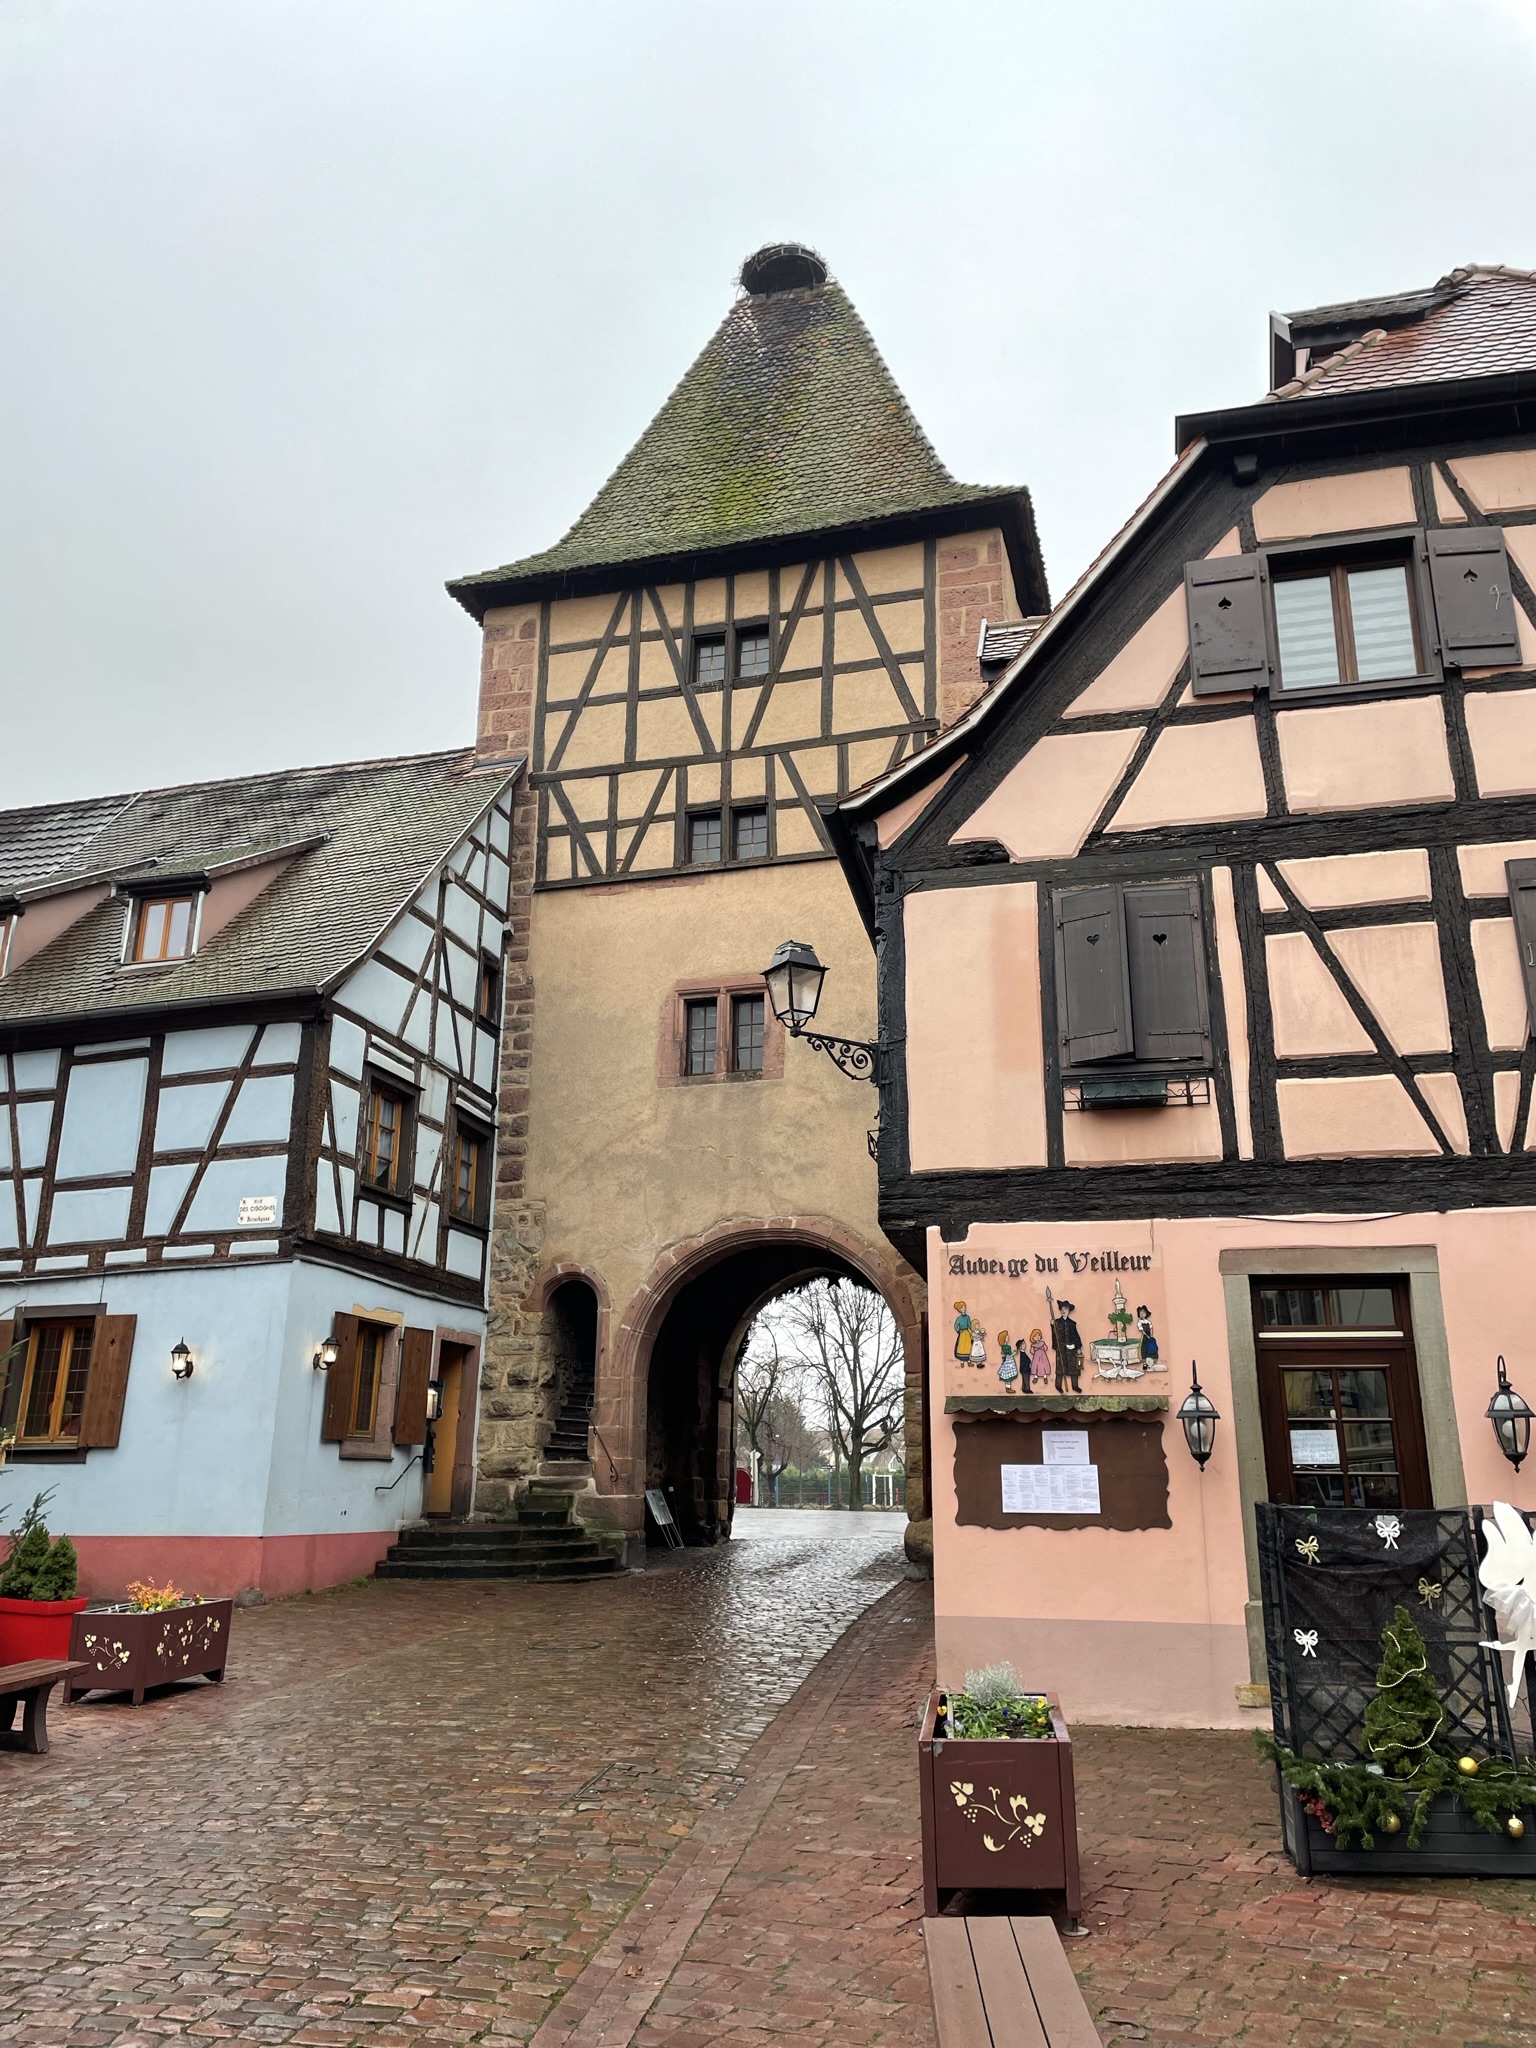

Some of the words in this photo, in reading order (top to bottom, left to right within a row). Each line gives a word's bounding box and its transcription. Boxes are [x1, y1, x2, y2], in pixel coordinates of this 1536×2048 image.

[949, 1254, 1029, 1278] Auberge
[1035, 1253, 1059, 1273] du
[1064, 1251, 1152, 1274] Veilleur
